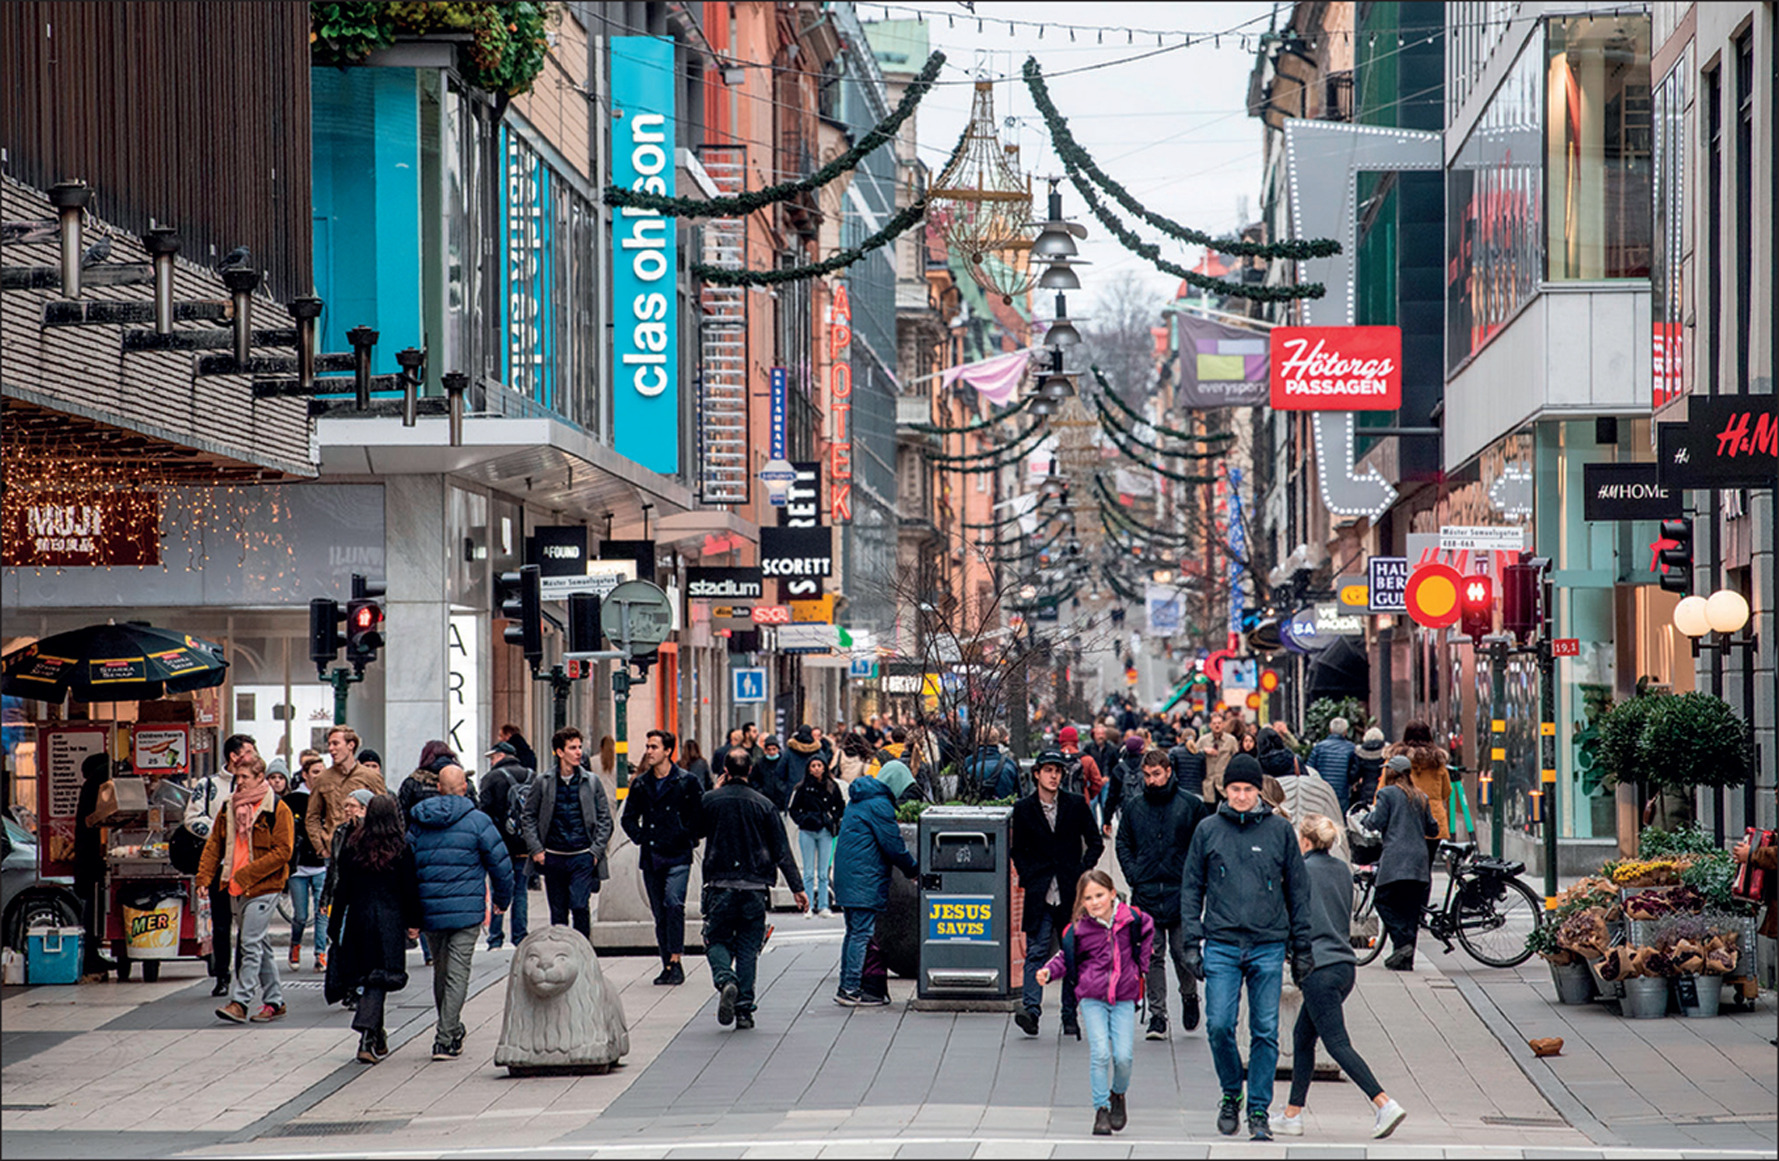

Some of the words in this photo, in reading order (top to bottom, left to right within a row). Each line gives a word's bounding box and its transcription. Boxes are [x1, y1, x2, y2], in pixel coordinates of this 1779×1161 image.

[622, 114, 666, 282] ohlson
[622, 292, 667, 397] clas
[1281, 338, 1394, 380] Hötorgs
[1286, 379, 1386, 394] PASSAGEN
[831, 285, 851, 519] APOTEK
[1716, 412, 1778, 458] H&M
[28, 505, 101, 536] MUJI
[1470, 528, 1520, 538] Samuelsgatan
[762, 558, 830, 575] SCORETT
[688, 579, 760, 595] stadium
[1376, 577, 1406, 590] BER
[1316, 618, 1359, 630] MODA
[1555, 642, 1576, 653] 19,1
[929, 904, 992, 920] JESUS
[132, 914, 169, 937] MER
[937, 922, 984, 935] SAVES
